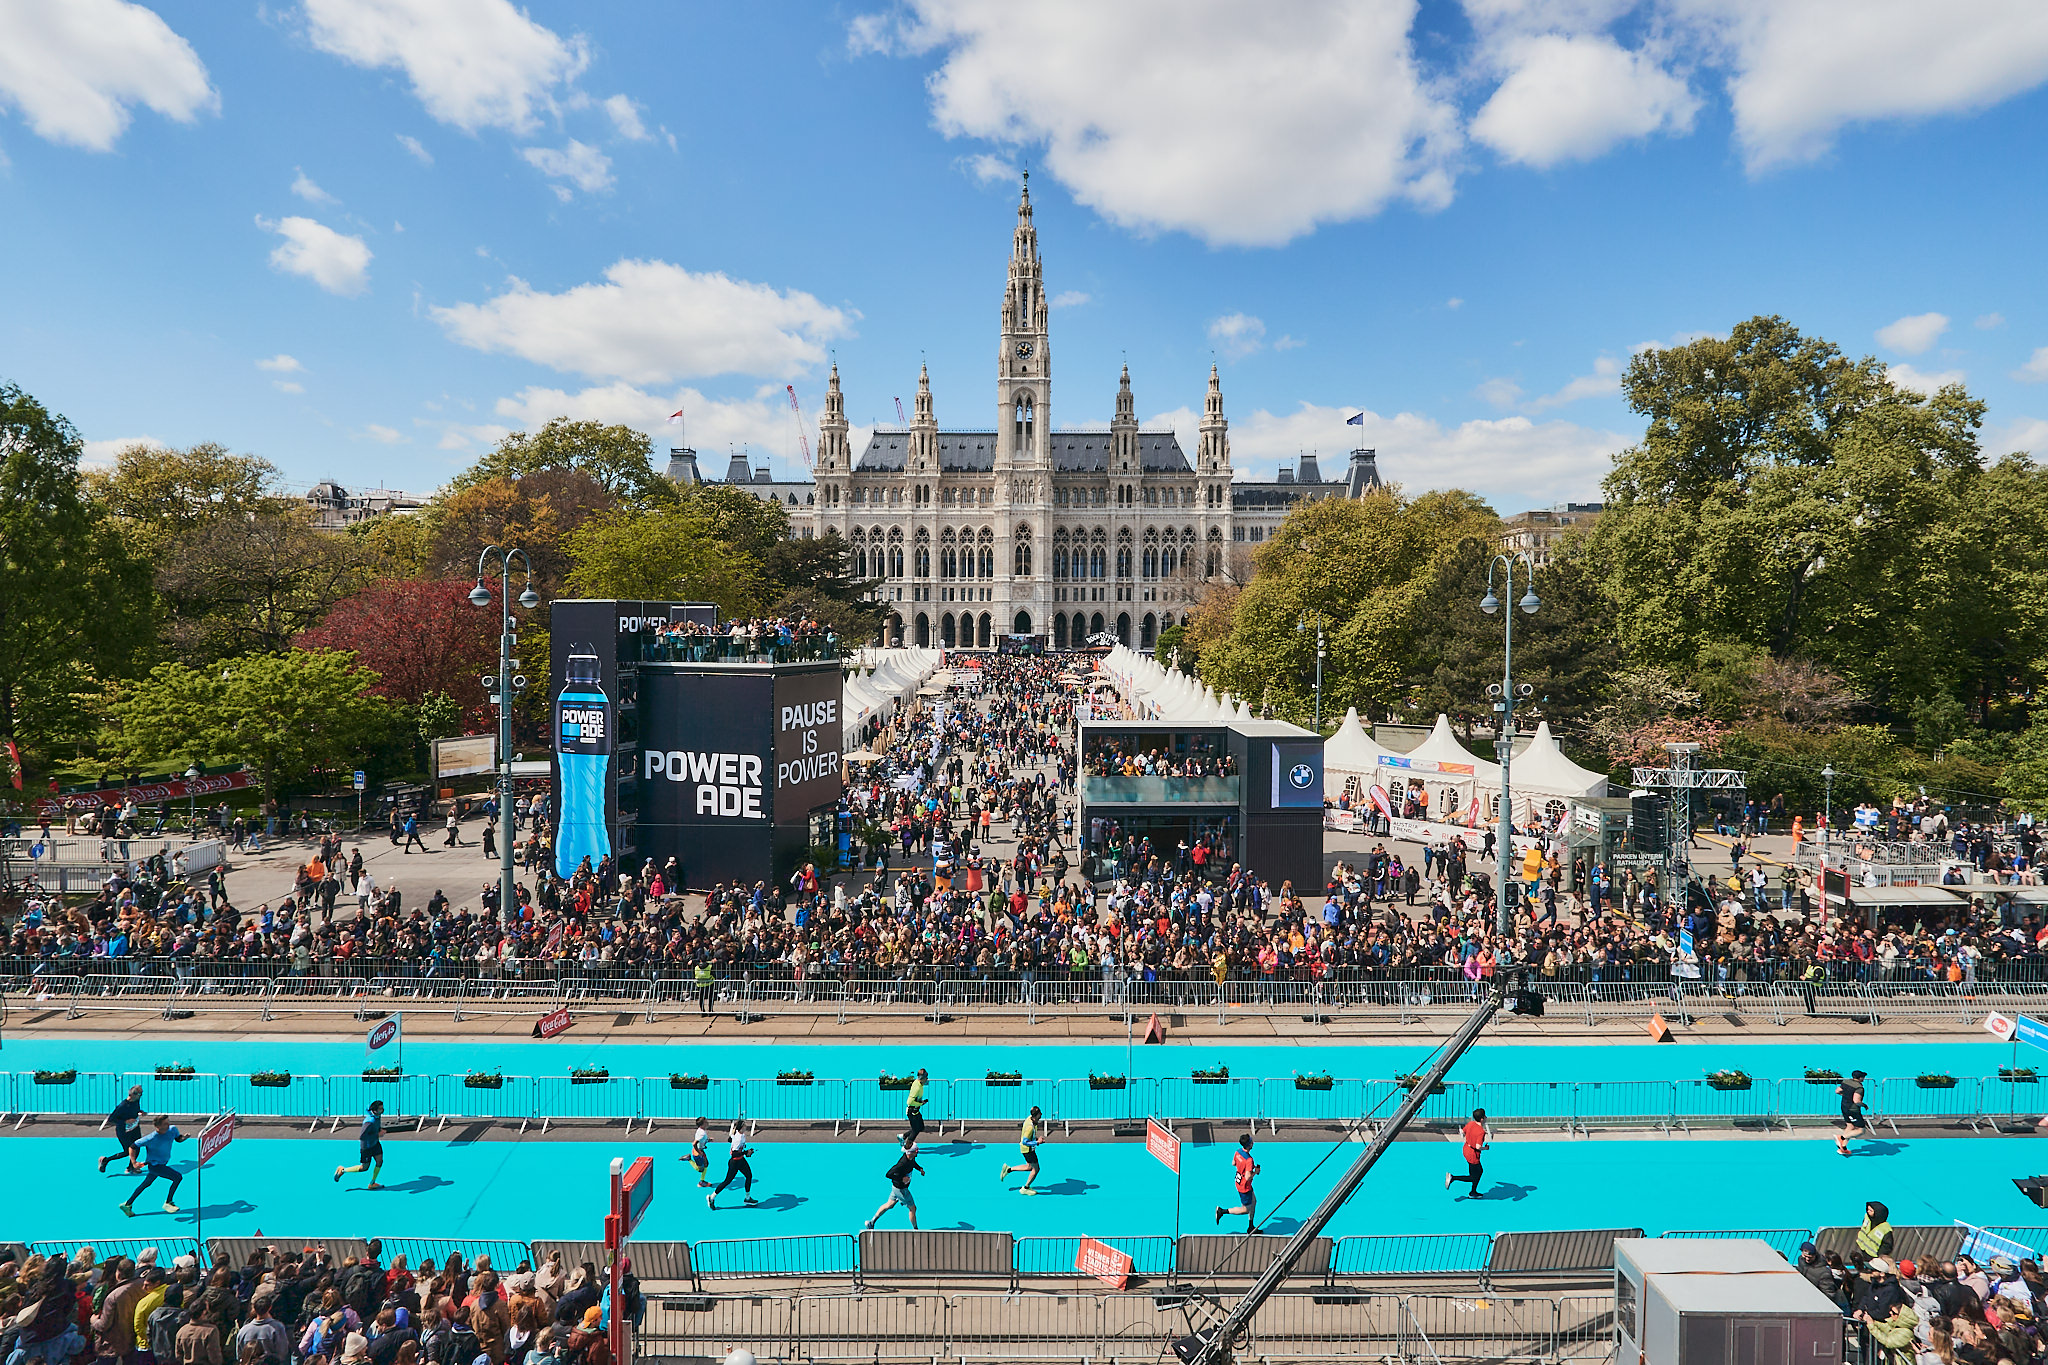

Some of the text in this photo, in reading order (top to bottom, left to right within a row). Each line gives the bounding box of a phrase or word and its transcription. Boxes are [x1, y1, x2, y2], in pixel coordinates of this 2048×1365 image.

[562, 710, 604, 724] POWER
[781, 699, 837, 732] PAUSE
[802, 729, 817, 755] IS
[644, 750, 762, 786] POWER
[778, 751, 838, 789] POWER
[1393, 821, 1418, 829] AUSTRIA
[372, 1025, 395, 1045] Hervis
[541, 1011, 568, 1035] Coca-Cola
[201, 1119, 234, 1159] Coca-Cola
